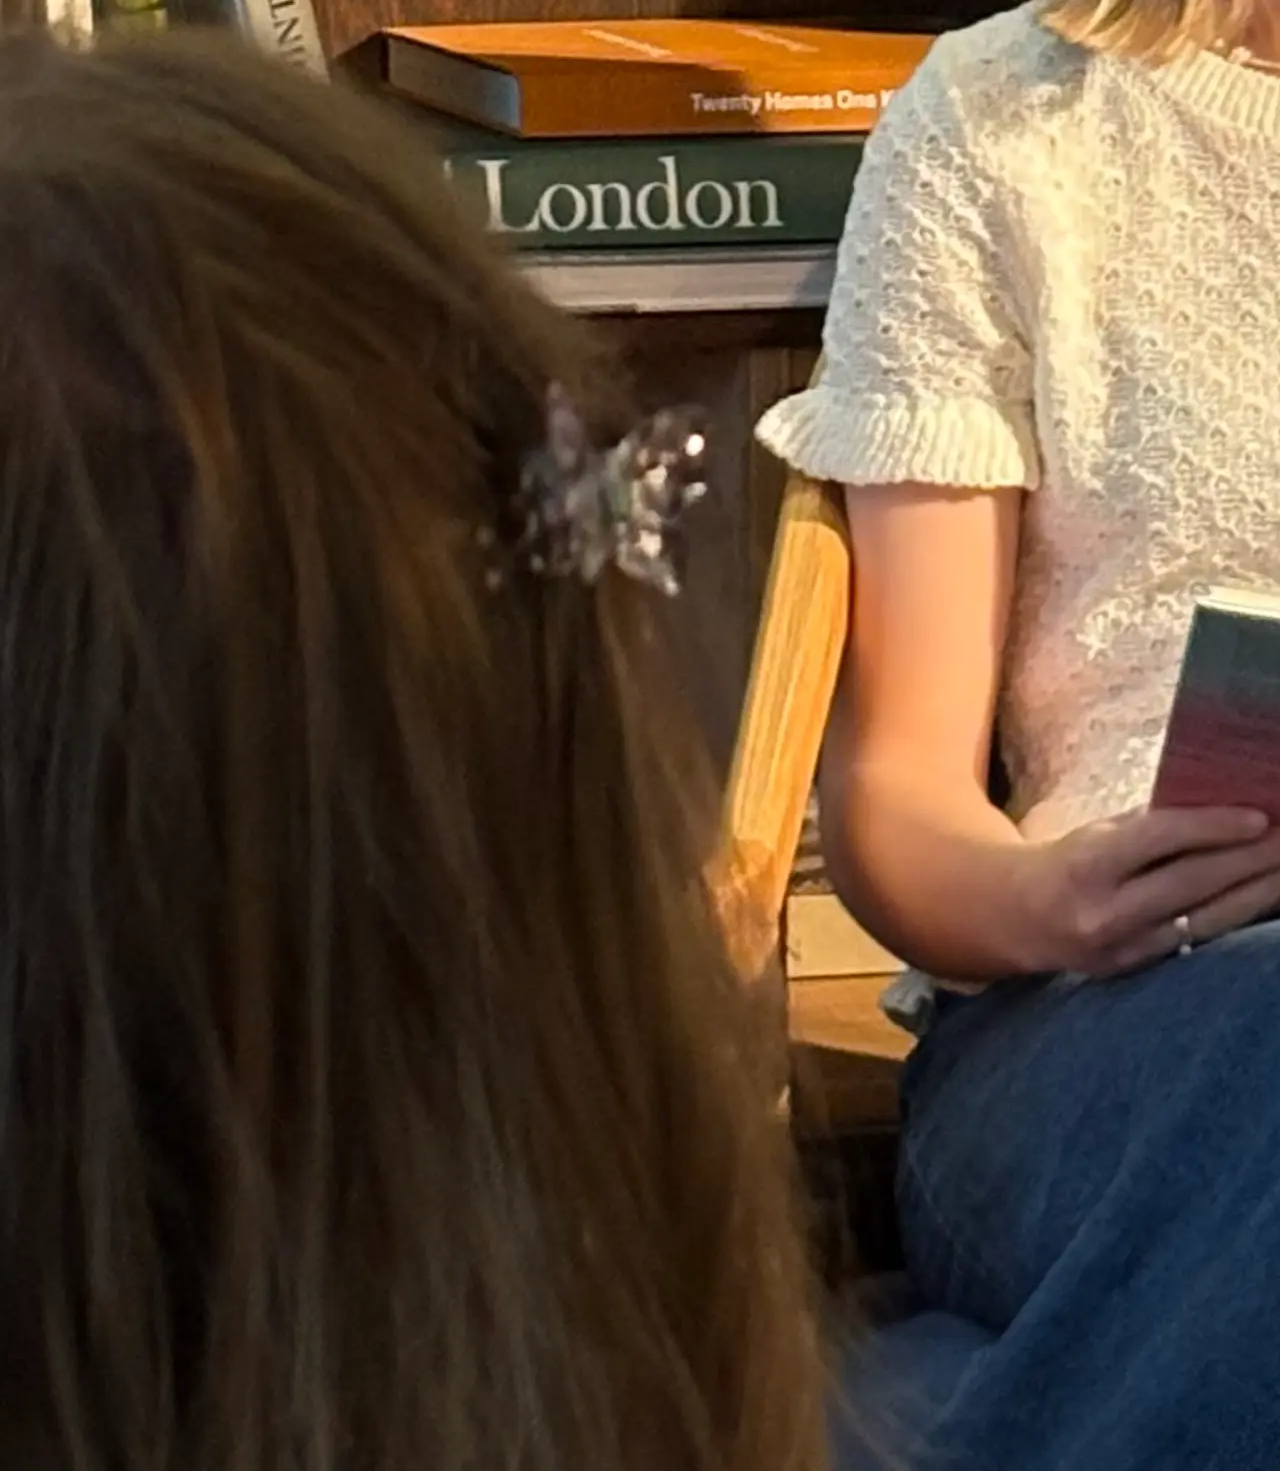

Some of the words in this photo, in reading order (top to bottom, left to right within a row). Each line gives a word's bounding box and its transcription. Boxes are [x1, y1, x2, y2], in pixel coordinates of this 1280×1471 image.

[690, 92, 762, 115] Twenty
[765, 90, 833, 111] Homes
[836, 89, 877, 110] One
[477, 155, 786, 231] London
